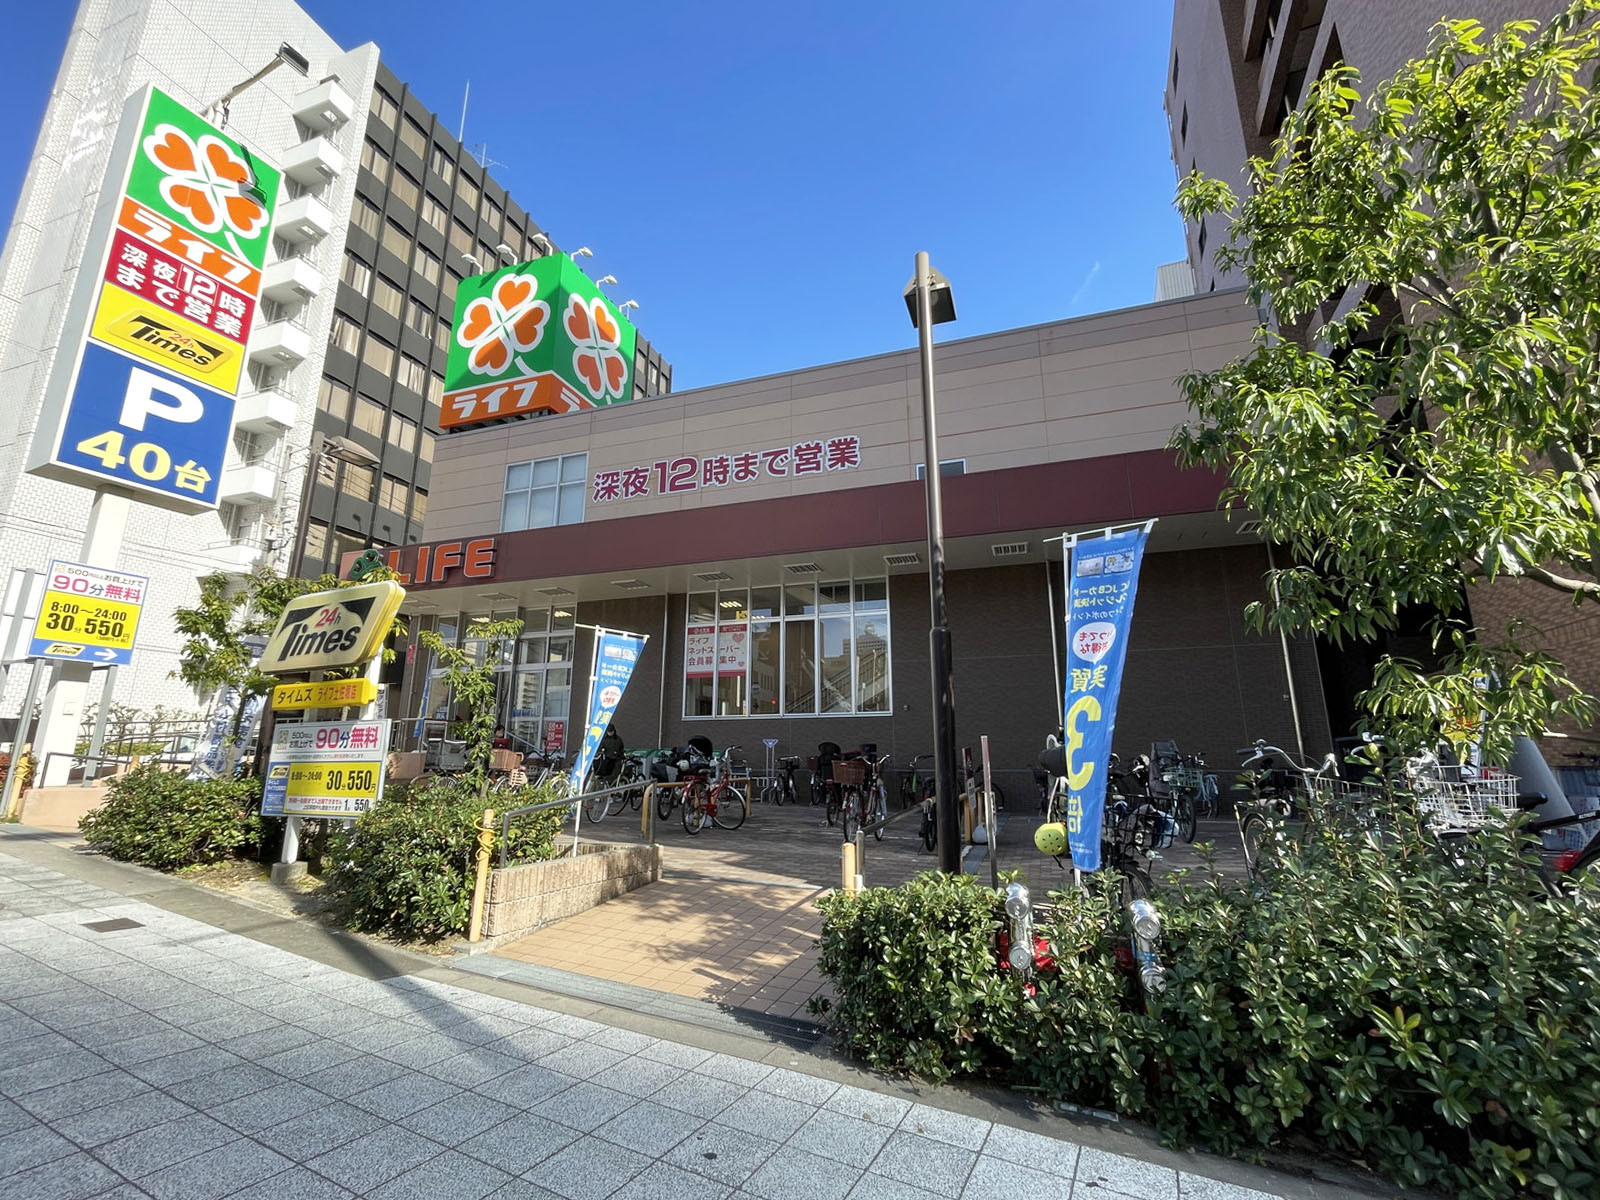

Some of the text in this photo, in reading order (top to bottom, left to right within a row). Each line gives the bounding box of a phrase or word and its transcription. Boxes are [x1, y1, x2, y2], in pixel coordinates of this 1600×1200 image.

[134, 207, 251, 284] ライフ
[116, 263, 243, 339] まで営業
[122, 242, 246, 318] 深夜12時
[130, 319, 215, 366] Times
[119, 366, 204, 432] P
[453, 381, 538, 418] ライフ
[76, 430, 211, 493] 40台
[592, 435, 860, 502] 深夜12時まで営業
[388, 538, 494, 583] LIFE
[53, 575, 140, 602] 90分無料
[84, 618, 130, 640] 550円
[277, 615, 363, 662] Times
[315, 607, 341, 627] 24h
[689, 637, 709, 645] ライフ
[315, 726, 378, 749] 90分無料
